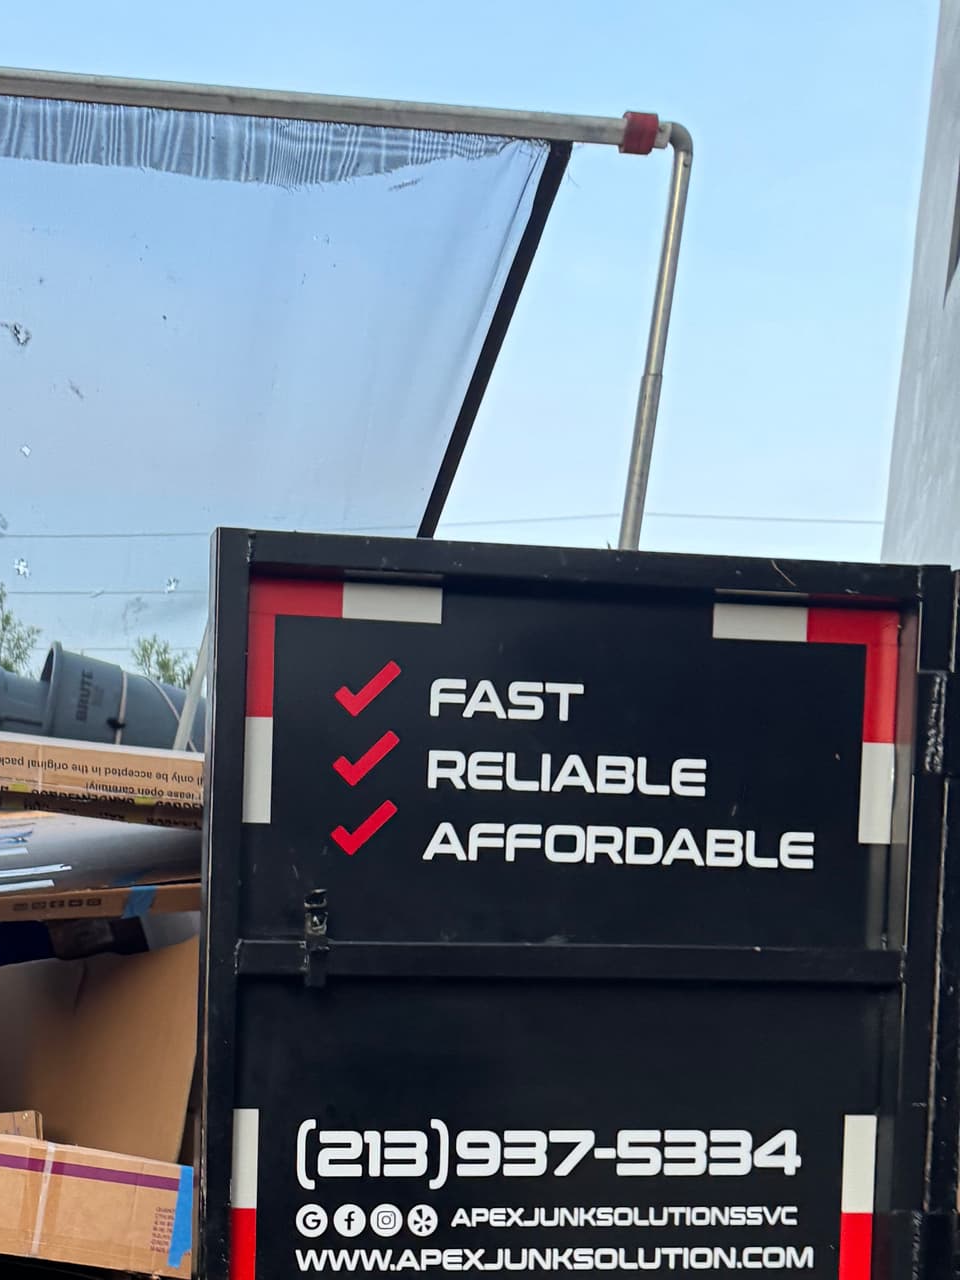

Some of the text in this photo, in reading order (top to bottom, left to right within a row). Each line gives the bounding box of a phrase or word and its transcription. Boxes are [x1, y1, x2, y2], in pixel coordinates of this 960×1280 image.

[429, 678, 585, 722] FAST
[27, 758, 69, 771] original
[71, 763, 89, 774] the
[91, 766, 101, 775] in
[104, 766, 153, 780] accepted
[155, 772, 169, 783] be
[171, 771, 194, 783] only
[427, 749, 707, 797] RELIABLE
[137, 786, 165, 797] open
[422, 822, 815, 869] AFFORDABLE
[296, 1118, 802, 1190] (213)937-5334
[450, 1206, 798, 1228] APEXJUNKSOLUTIONSSVC
[295, 1246, 814, 1272] WWW.APEXJUNKSOLUTION.COM
